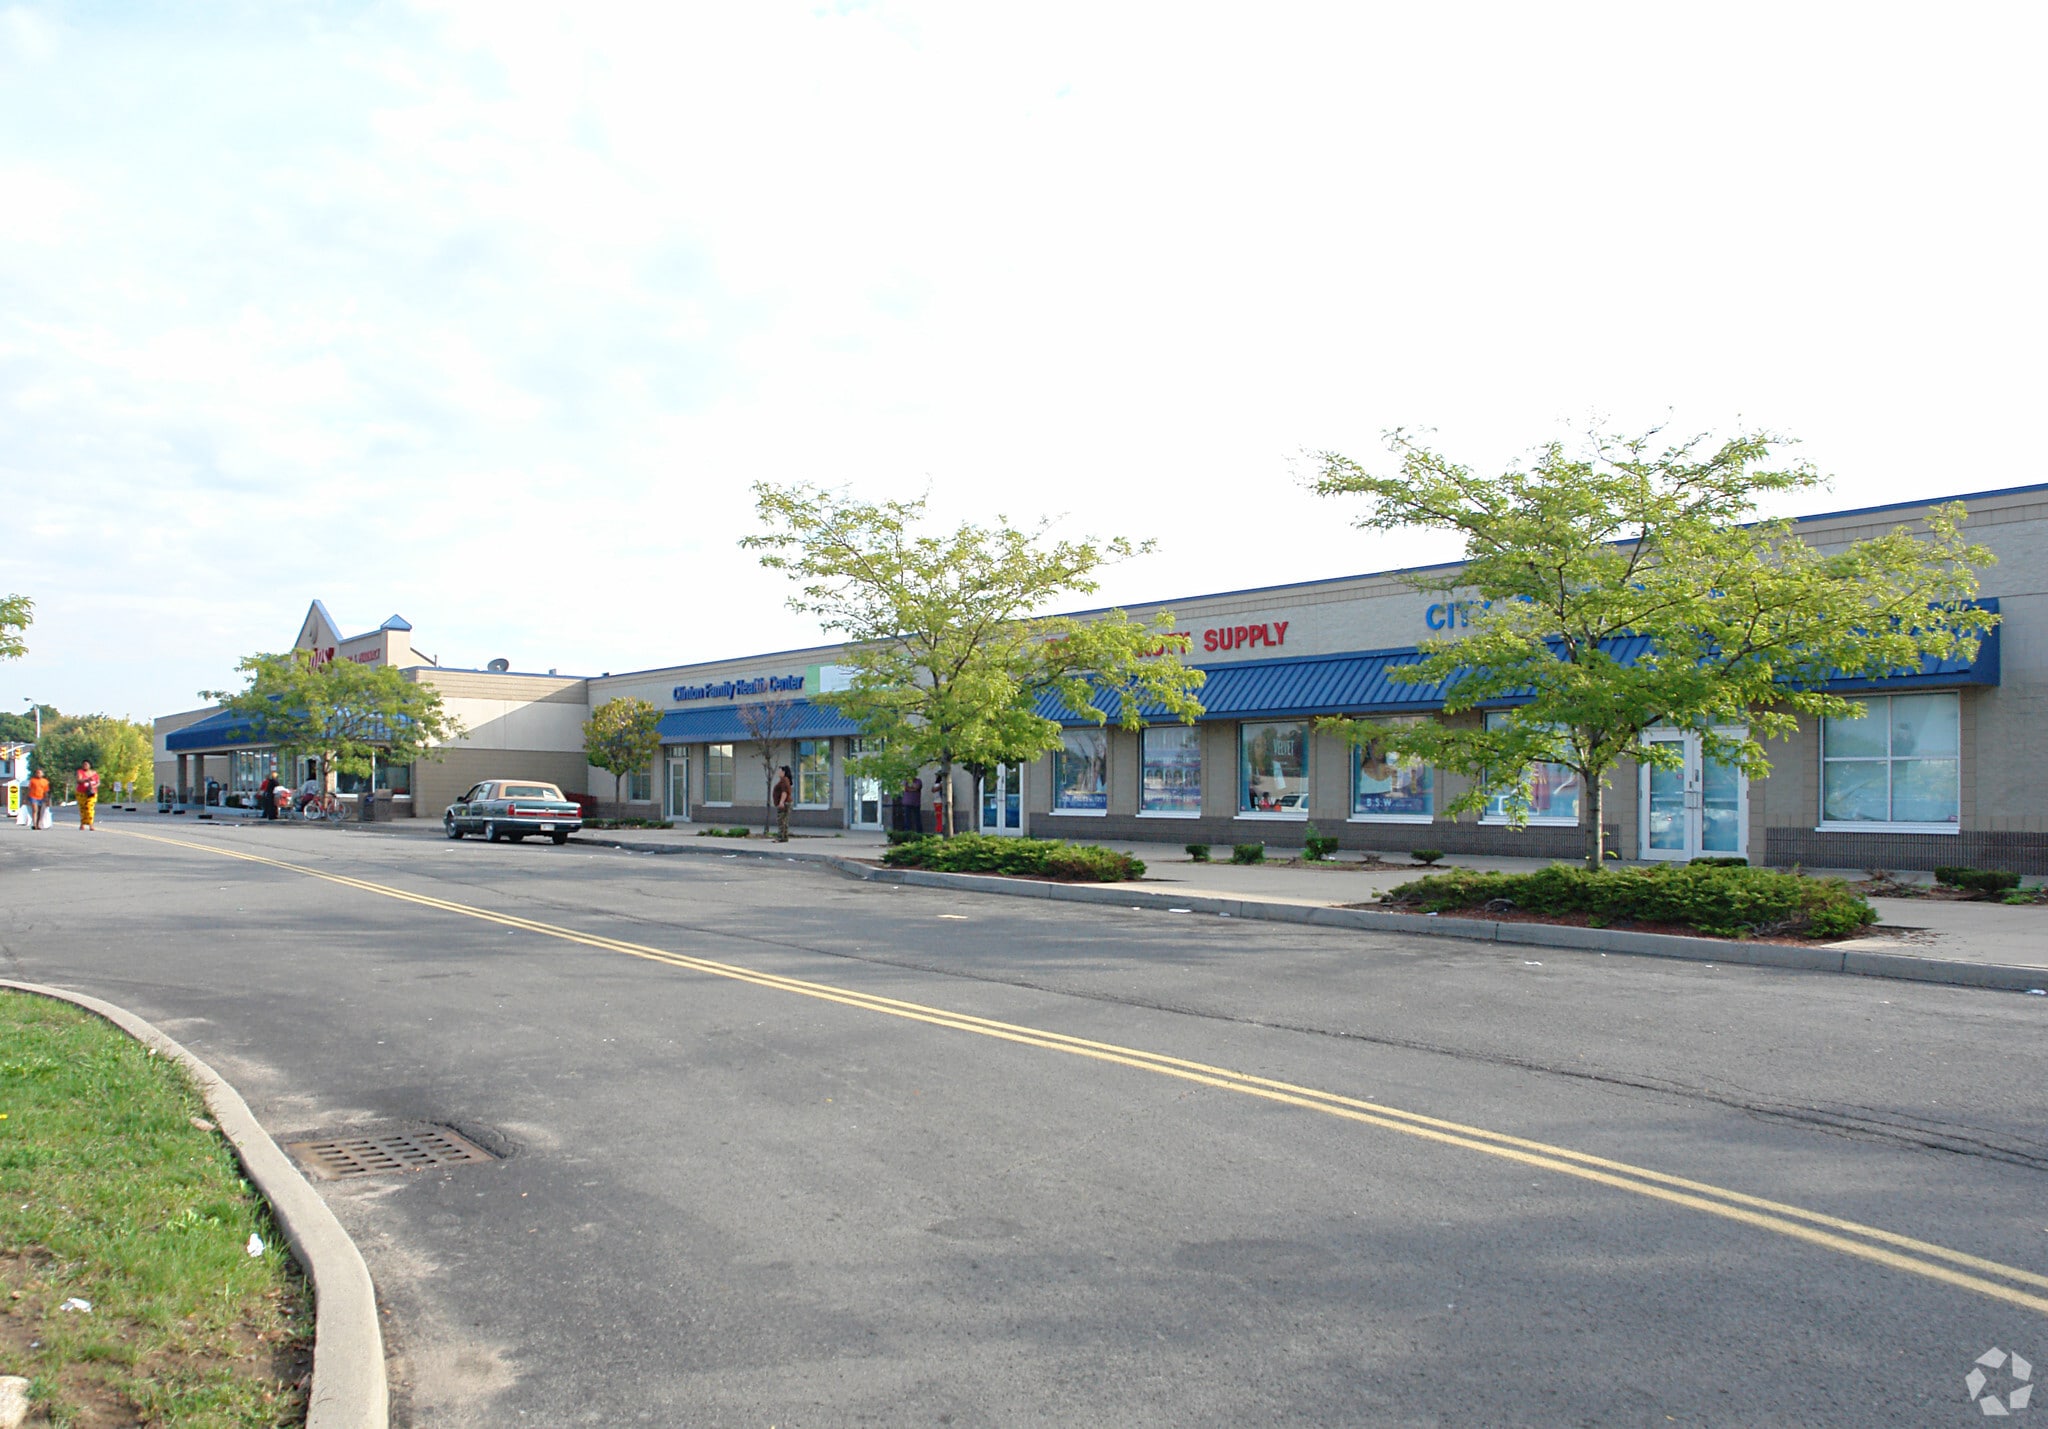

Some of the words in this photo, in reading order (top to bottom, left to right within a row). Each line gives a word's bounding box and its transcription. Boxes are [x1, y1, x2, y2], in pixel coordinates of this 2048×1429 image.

[1203, 620, 1289, 652] SUPPLY
[672, 685, 705, 702] Clinton
[703, 681, 736, 700] Family
[735, 677, 768, 696] Health
[769, 674, 805, 693] Center
